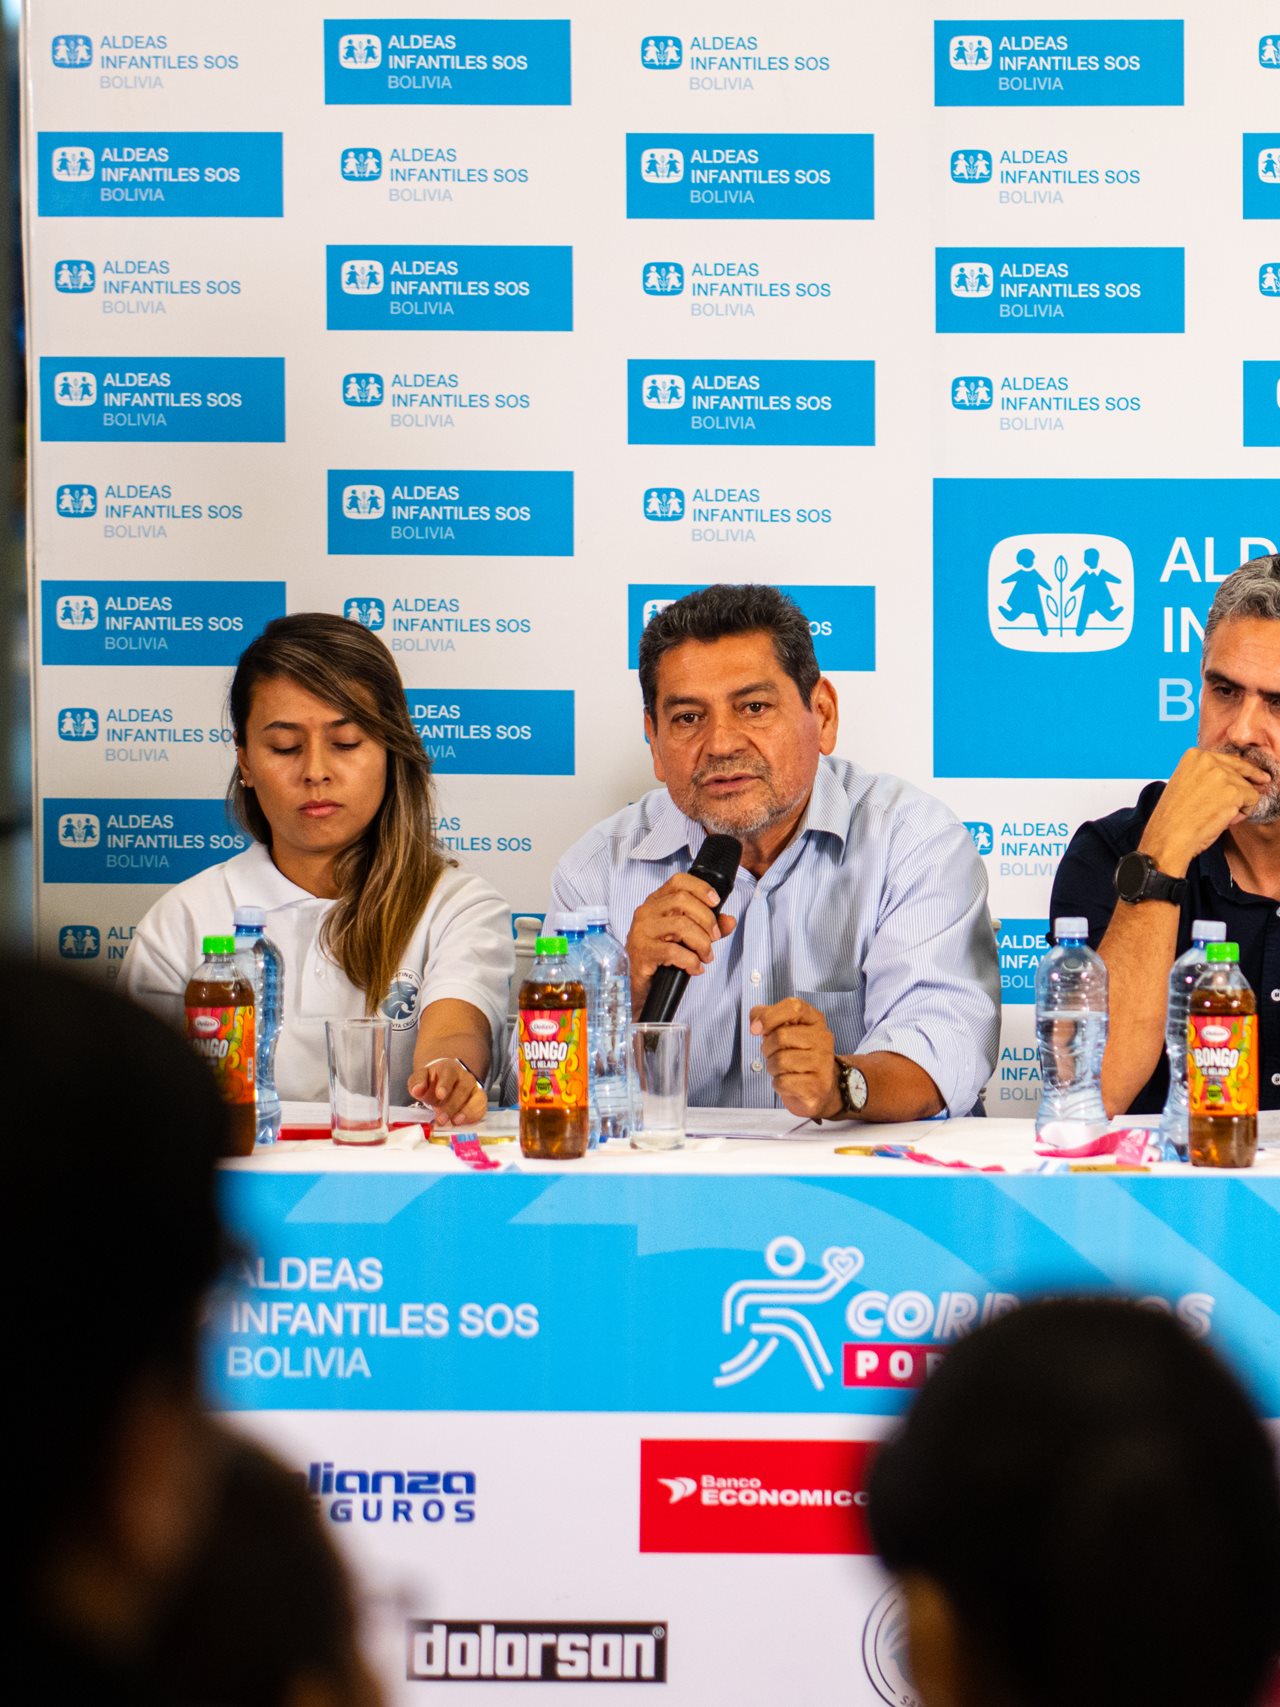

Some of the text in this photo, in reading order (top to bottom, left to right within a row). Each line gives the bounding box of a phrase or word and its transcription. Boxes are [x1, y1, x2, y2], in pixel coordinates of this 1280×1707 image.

[100, 36, 167, 49] ALDEAS
[388, 35, 456, 49] ALDEAS
[999, 36, 1067, 50] ALDEAS
[101, 55, 238, 69] INFANTILES SOS
[389, 55, 527, 70] INFANTILES SOS
[1000, 56, 1140, 70] INFANTILES SOS
[100, 76, 163, 89] BOLIVIA
[388, 75, 452, 88] BOLIVIA
[999, 77, 1063, 90] BOLIVIA
[102, 148, 168, 162] ALDEAS
[691, 150, 758, 163] ALDEAS
[102, 168, 240, 182] INFANTILES SOS
[692, 170, 830, 184] INFANTILES SOS
[101, 188, 164, 201] BOLIVIA
[690, 190, 754, 203] BOLIVIA
[391, 261, 458, 275] ALDEAS
[1001, 263, 1068, 277] ALDEAS
[391, 281, 529, 296] INFANTILES SOS
[1001, 284, 1140, 298] INFANTILES SOS
[390, 302, 454, 314] BOLIVIA
[1000, 304, 1064, 317] BOLIVIA
[104, 373, 170, 387] ALDEAS
[692, 376, 760, 390] ALDEAS
[104, 393, 241, 407] INFANTILES SOS
[693, 396, 831, 410] INFANTILES SOS
[103, 413, 166, 426] BOLIVIA
[692, 416, 755, 429] BOLIVIA
[392, 486, 459, 500] ALDEAS
[392, 506, 530, 520] INFANTILES SOS
[392, 526, 455, 539] BOLIVIA
[105, 597, 172, 611] ALDEAS
[106, 617, 243, 631] INFANTILES SOS
[105, 637, 168, 650] BOLIVIA
[107, 709, 173, 723] ALDEAS
[106, 729, 204, 743] INFANTILES
[496, 725, 532, 740] SOS
[105, 749, 168, 762] BOLIVIA
[108, 815, 173, 828] ALDEAS
[1001, 823, 1069, 837] ALDEAS
[108, 835, 245, 849] INFANTILES SOS
[497, 837, 532, 851] SOS
[107, 855, 169, 867] BOLIVIA
[1000, 863, 1056, 876] BOLIVI
[523, 1041, 568, 1061] BONGO
[1194, 1047, 1240, 1068] BONGO
[231, 1302, 540, 1338] INFANTILES SOS
[227, 1347, 372, 1378] BOLIVIA
[308, 1462, 477, 1495] lianza
[702, 1475, 762, 1489] Banco
[329, 1498, 477, 1523] GUROS
